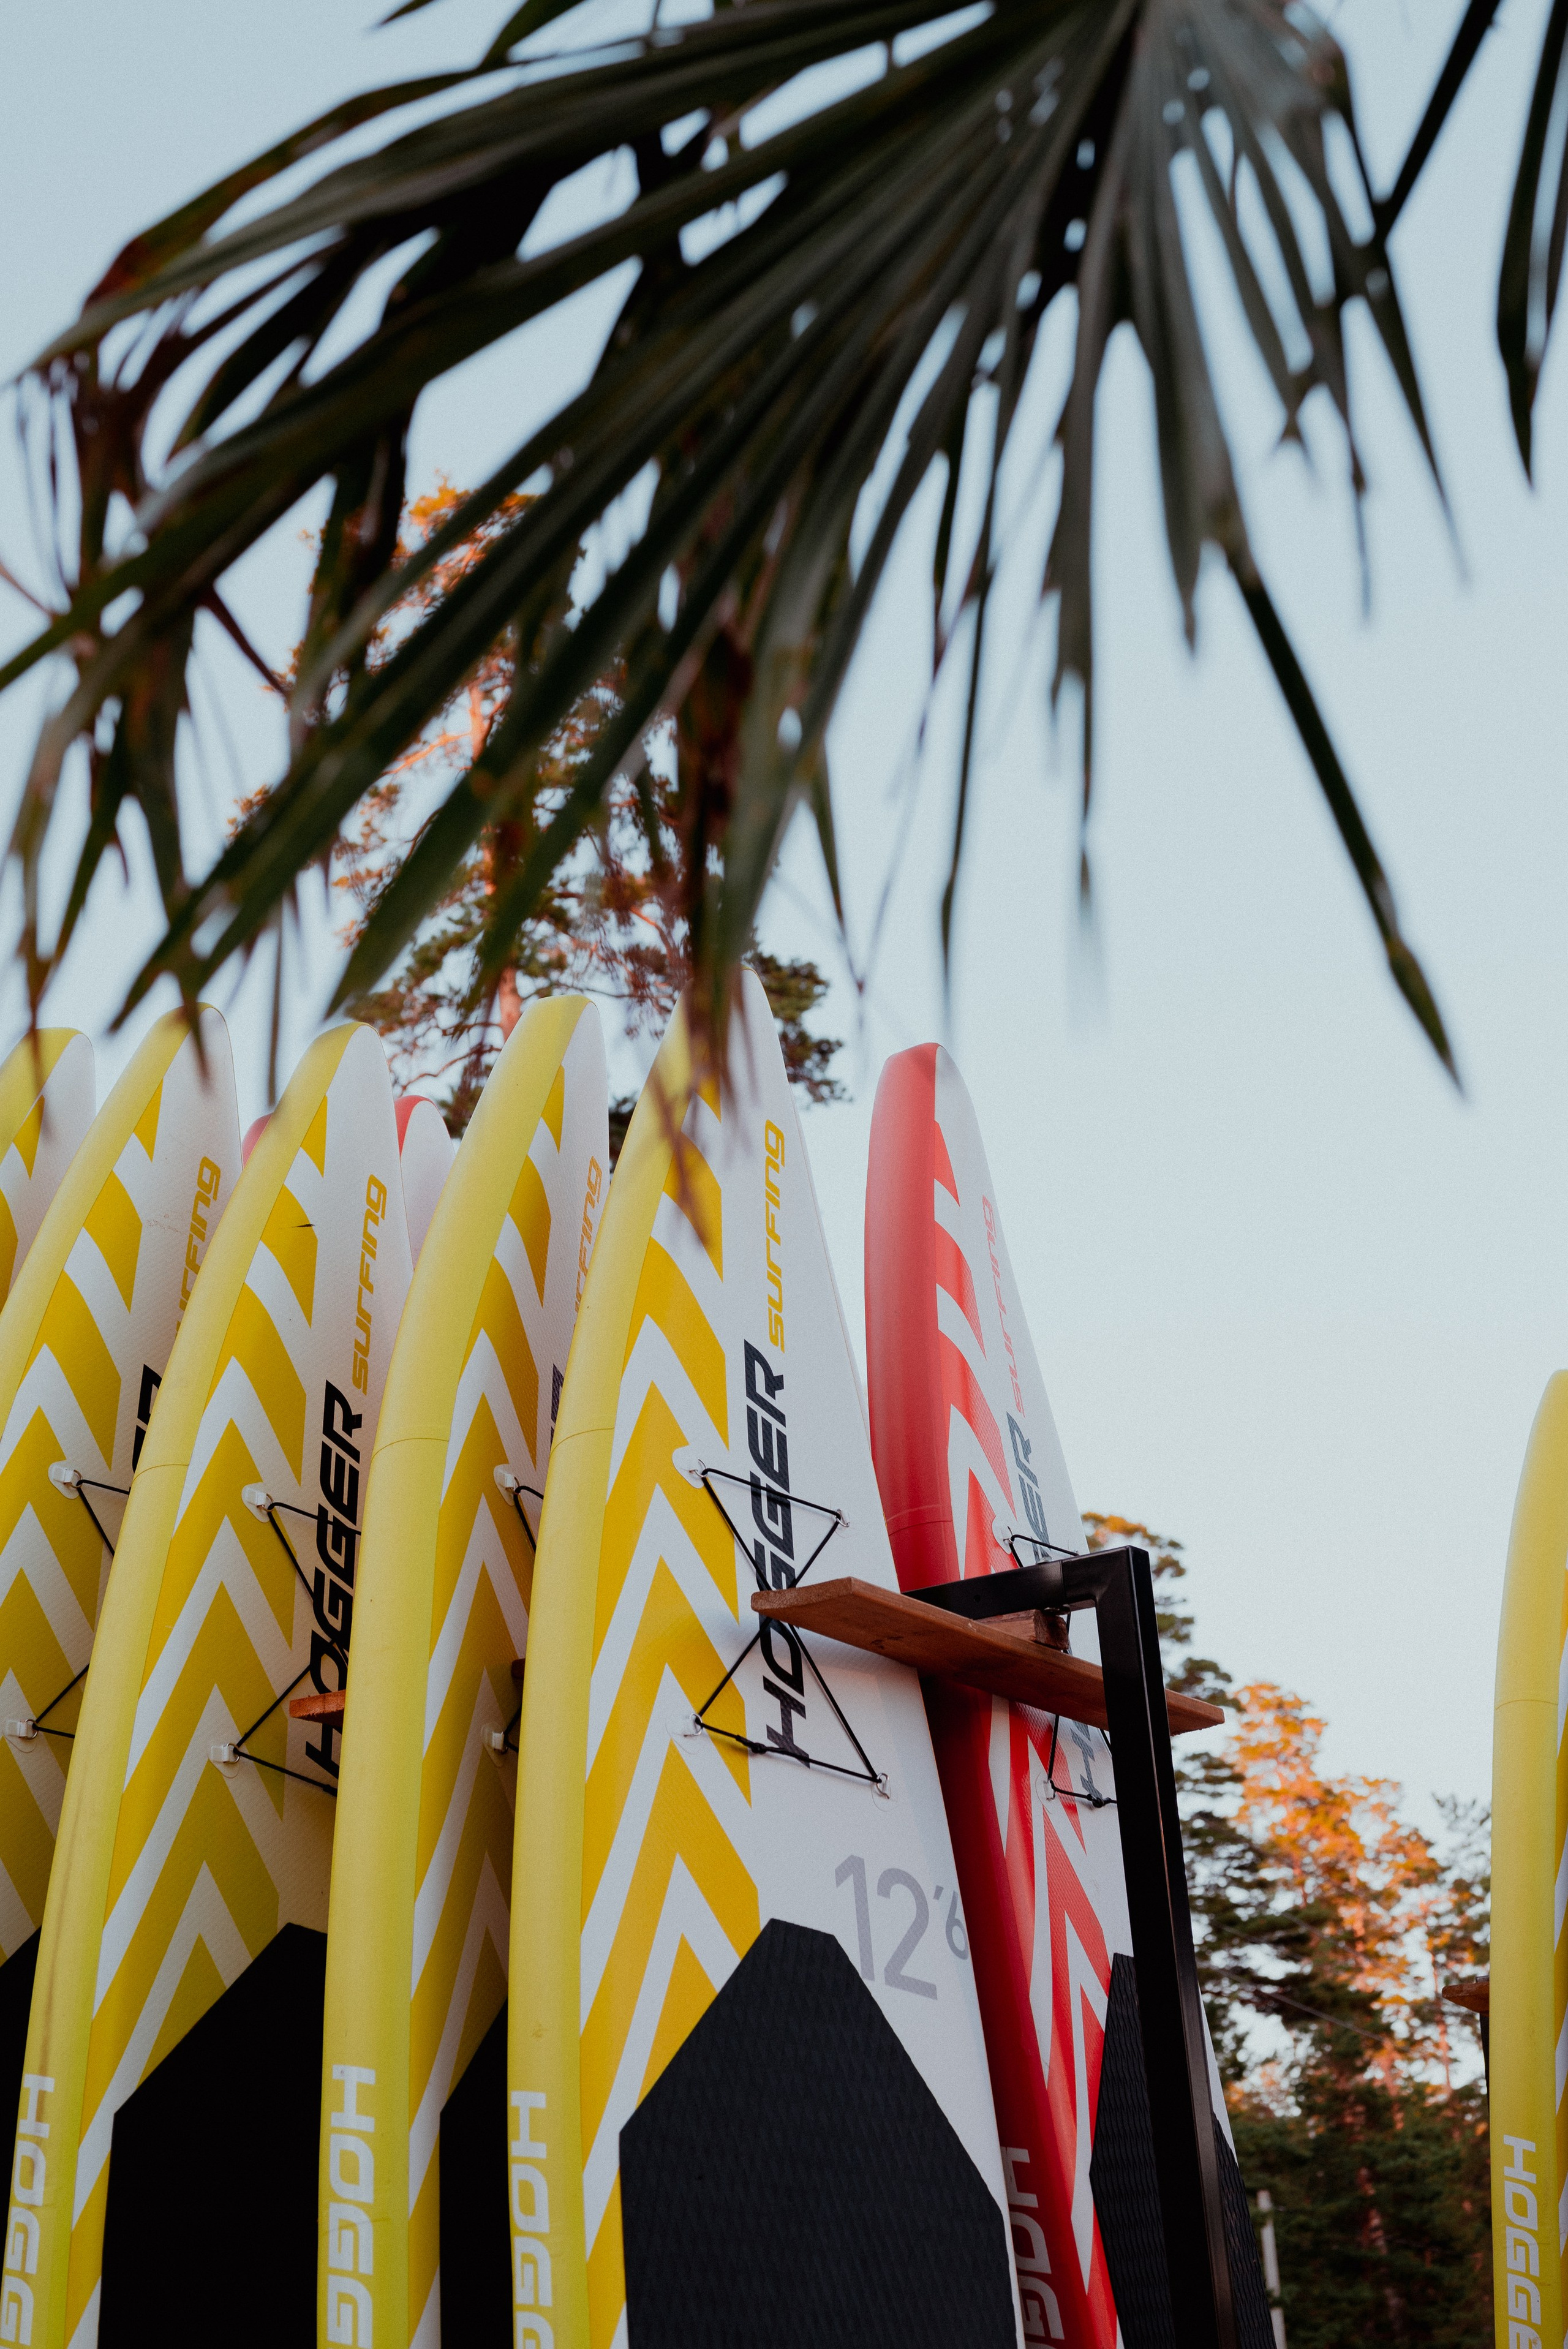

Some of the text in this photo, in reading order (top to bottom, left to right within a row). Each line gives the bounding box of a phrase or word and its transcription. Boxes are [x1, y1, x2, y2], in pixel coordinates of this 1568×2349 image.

[0, 2074, 55, 2349] HOGG
[327, 2064, 375, 2349] HOGG
[1000, 2146, 1065, 2349] HOG
